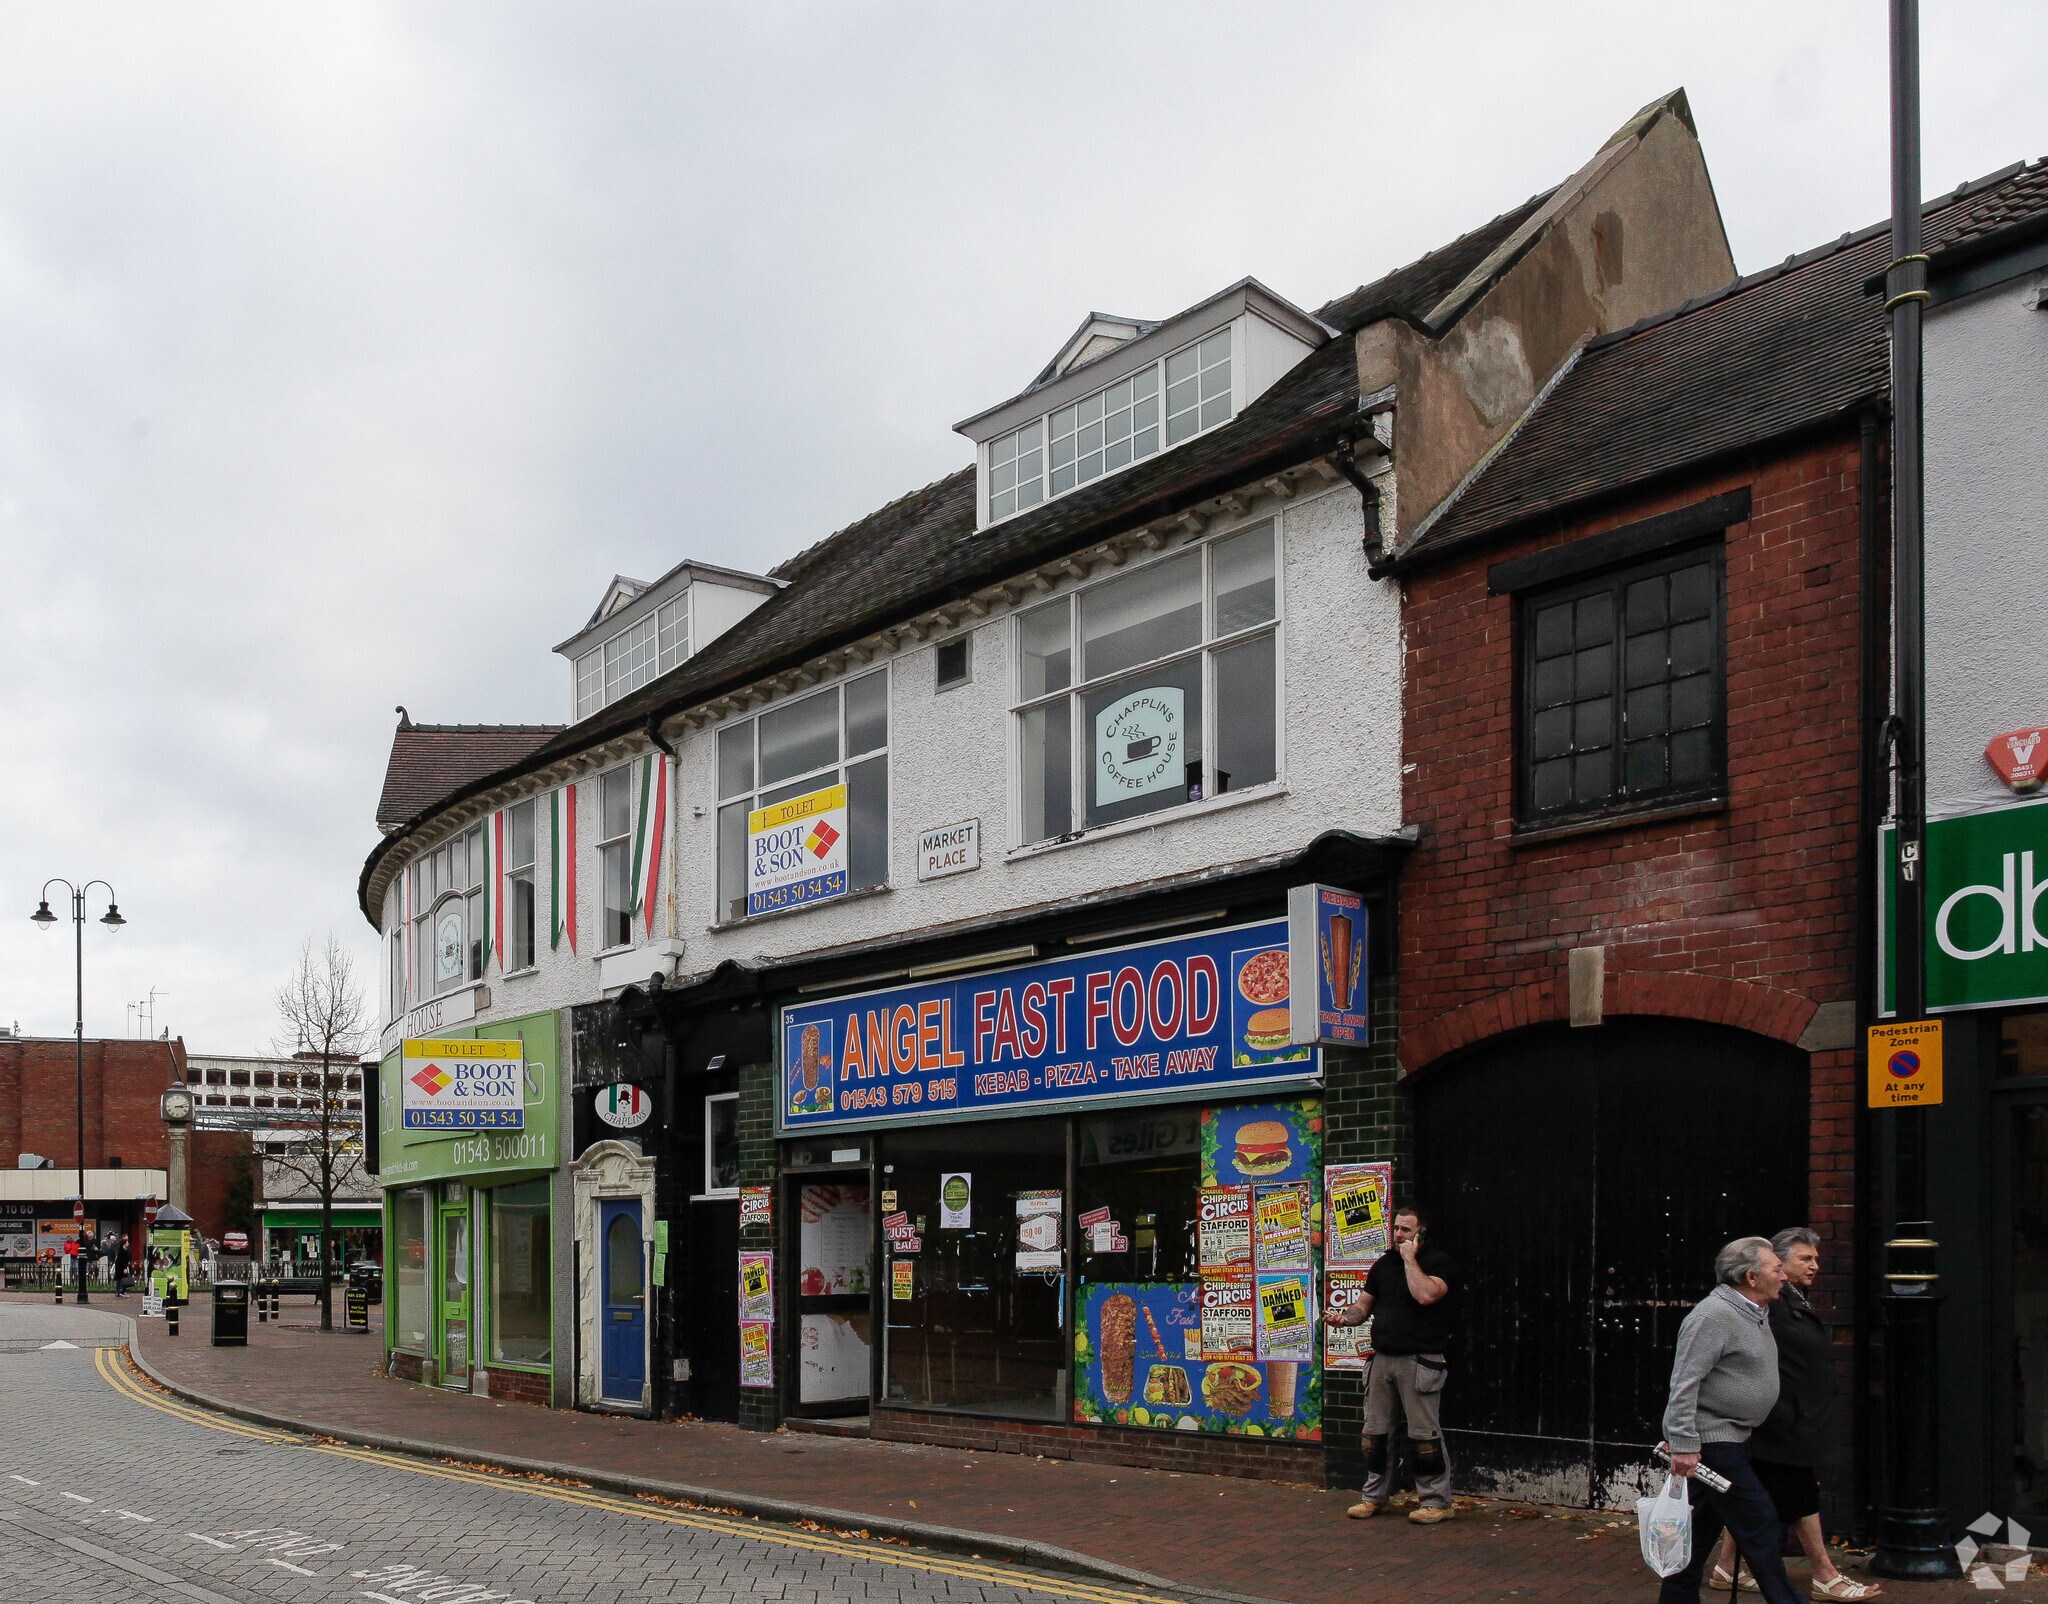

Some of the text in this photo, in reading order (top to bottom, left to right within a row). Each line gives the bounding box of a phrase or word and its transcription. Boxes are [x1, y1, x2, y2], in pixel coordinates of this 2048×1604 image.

[1106, 698, 1174, 738] CHAPPLINS
[2006, 735, 2041, 749] VANGUARD
[1102, 731, 1178, 788] COFFEE HOUSE
[781, 798, 815, 819] TO LET
[754, 825, 804, 857] BOOT
[923, 826, 973, 852] MARKET
[929, 848, 966, 871] PLACE
[1903, 844, 1915, 859] C
[754, 846, 804, 877] & SON
[754, 859, 840, 888] www.bootandson.co.uk
[754, 874, 841, 911] 01543 50 54 54
[1322, 890, 1361, 910] KEBABS
[974, 954, 1220, 1064] FAST FOOD
[406, 1001, 443, 1038] HOUSE
[785, 1014, 795, 1025] 35
[1319, 1010, 1366, 1027] TAKE AWAY
[840, 998, 965, 1081] ANGEL
[1332, 1026, 1355, 1040] OPEN
[1871, 1025, 1938, 1037] Pedestrian
[442, 1045, 484, 1055] TO LET
[1889, 1037, 1919, 1047] Zone
[454, 1063, 517, 1080] BOOT
[975, 1069, 1030, 1096] KEBAB
[1045, 1061, 1097, 1088] PIZZA
[1111, 1053, 1160, 1081] TAKE
[1164, 1046, 1219, 1076] AWAY
[453, 1080, 516, 1097] & SON
[840, 1078, 957, 1110] 01543 579 515
[1884, 1082, 1925, 1092] At any
[411, 1099, 516, 1107] www.bootandson.co.uk
[1891, 1093, 1919, 1102] time
[411, 1111, 517, 1125] 01543 50 54 54
[604, 1109, 647, 1126] CHAPLINS
[453, 1133, 546, 1164] 01543 500011
[741, 1199, 769, 1214] CIRCUS
[1200, 1193, 1247, 1205] CHIPPERFIELD
[1334, 1190, 1377, 1211] DAMNED
[6, 1205, 34, 1214] TO GO
[1201, 1200, 1249, 1221] CIRCUS
[889, 1227, 914, 1238] JUST
[1200, 1220, 1249, 1231] STAFFORD
[895, 1239, 912, 1250] EAT
[1329, 1272, 1356, 1280] CHARLES
[1203, 1281, 1251, 1291] CHIPPERFIELD
[1330, 1280, 1367, 1290] CHIPPE
[1203, 1289, 1252, 1308] CIRCUS
[1262, 1288, 1301, 1308] DAMNED
[1330, 1288, 1362, 1307] CIR
[1165, 1307, 1197, 1325] Fast
[1202, 1308, 1251, 1318] STAFFORD
[1347, 1327, 1352, 1335] 9
